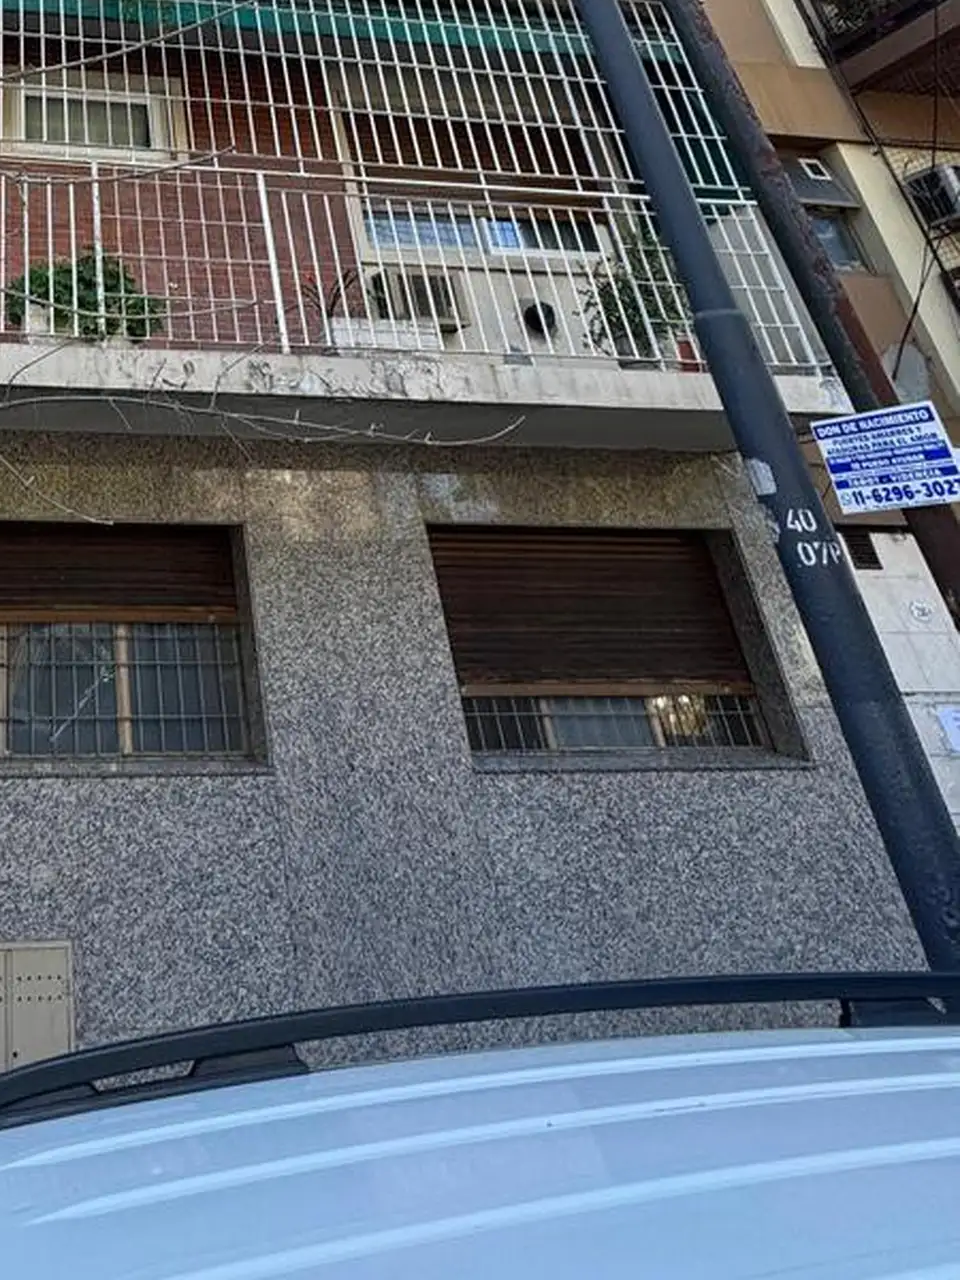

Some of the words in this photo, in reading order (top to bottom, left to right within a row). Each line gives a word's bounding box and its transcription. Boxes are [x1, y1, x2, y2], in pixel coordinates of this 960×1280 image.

[817, 426, 841, 437] DON
[842, 422, 858, 433] DE
[859, 409, 928, 429] NACIMIENTO
[787, 508, 817, 532] 40
